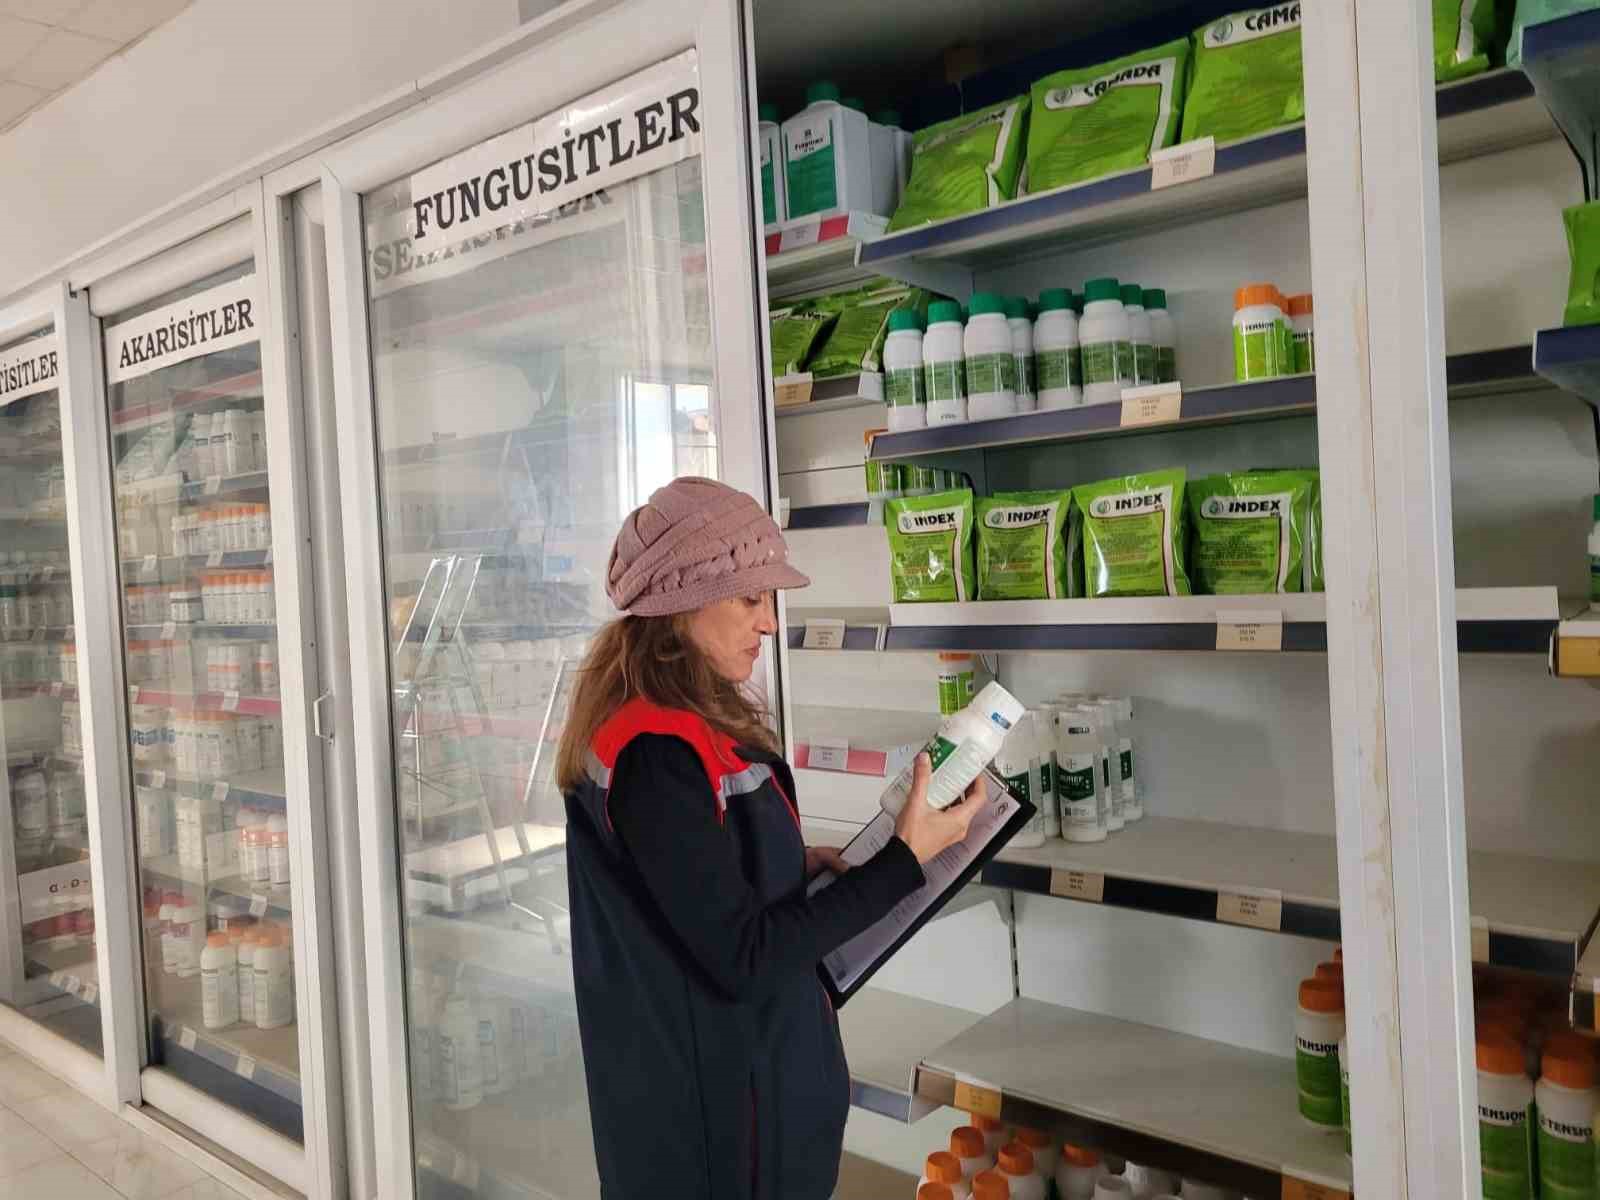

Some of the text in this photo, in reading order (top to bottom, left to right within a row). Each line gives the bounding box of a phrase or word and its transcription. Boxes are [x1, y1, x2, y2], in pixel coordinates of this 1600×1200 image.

[413, 87, 701, 240] FUNGUSİTLER
[119, 298, 254, 369] AKARİSİTLER
[1115, 492, 1163, 510] INDEX
[1228, 499, 1280, 512] INDEX
[914, 511, 955, 525] INDEX
[1007, 508, 1051, 522] INDEX
